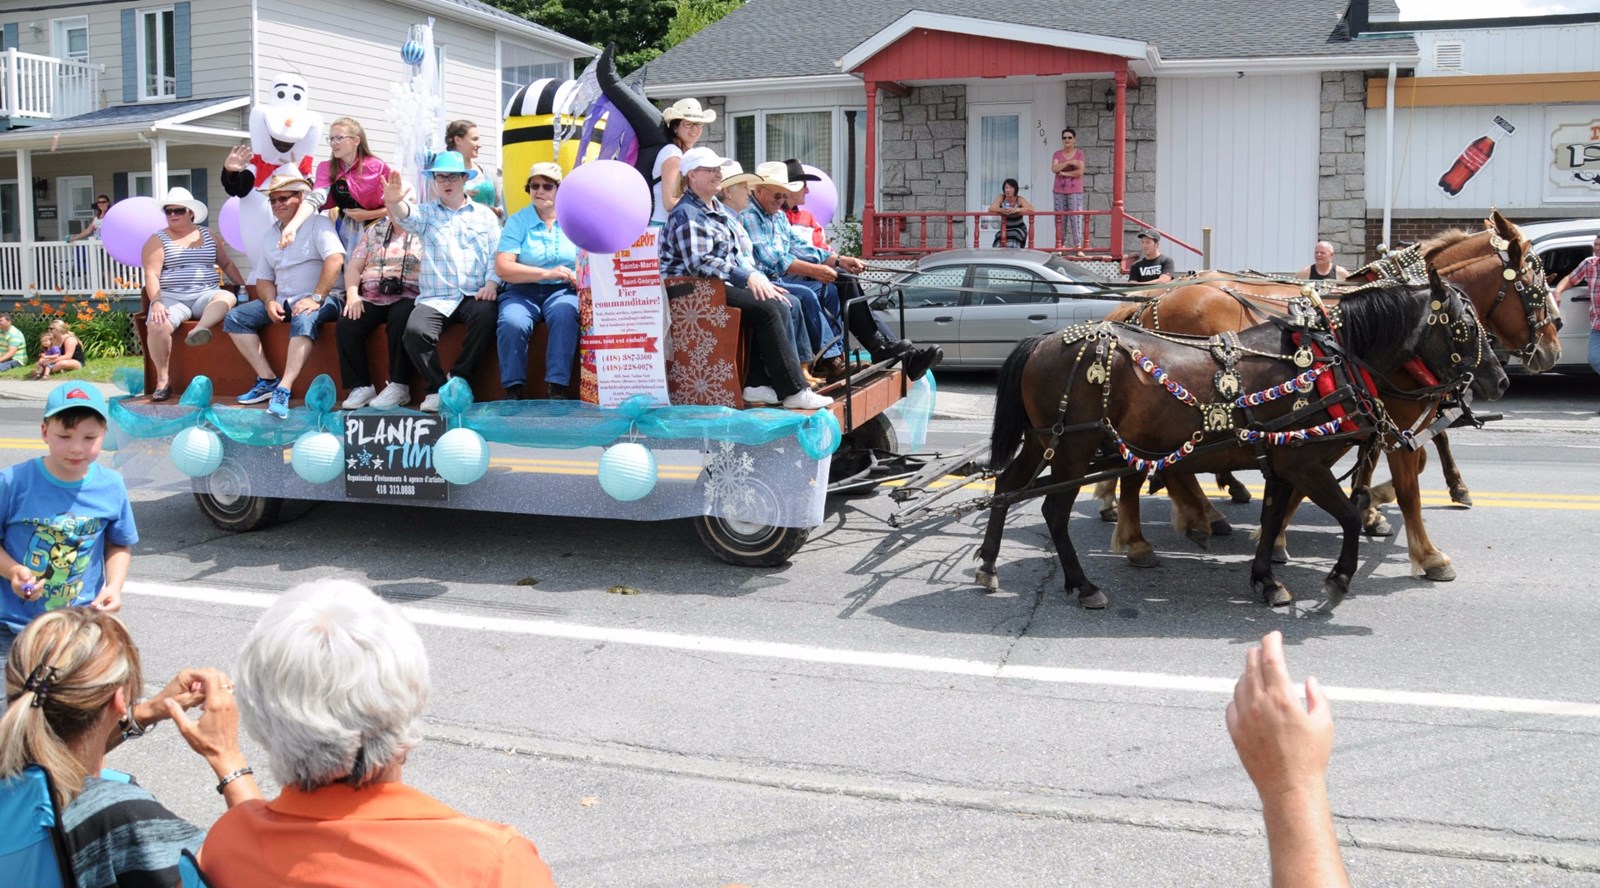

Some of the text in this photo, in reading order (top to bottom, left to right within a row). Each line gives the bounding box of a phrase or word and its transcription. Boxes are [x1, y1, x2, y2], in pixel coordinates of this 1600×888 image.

[1139, 264, 1162, 276] VANS
[622, 277, 660, 286] Saint-Georges
[618, 288, 636, 297] Fier
[594, 296, 661, 308] commanditaire!
[345, 416, 437, 445] PLANIF
[376, 484, 387, 495] 418
